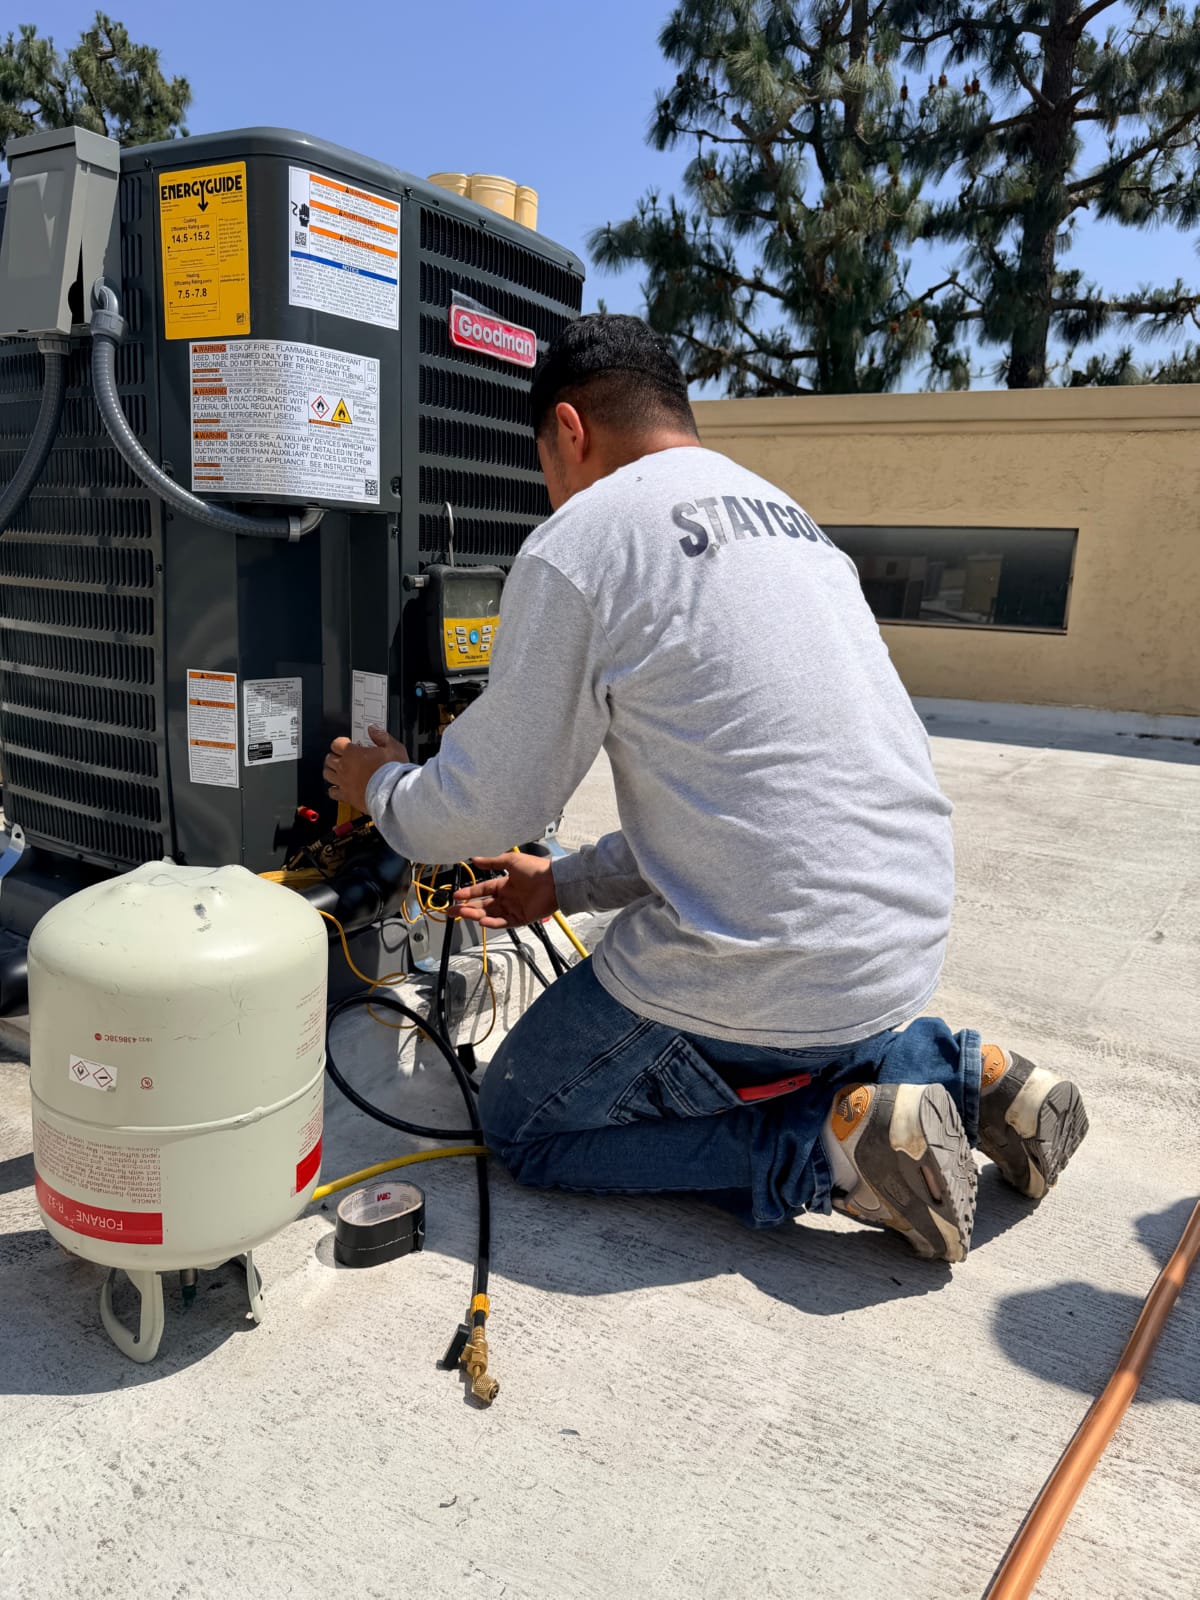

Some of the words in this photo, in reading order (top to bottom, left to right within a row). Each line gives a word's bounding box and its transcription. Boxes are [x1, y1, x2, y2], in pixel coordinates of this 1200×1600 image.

[161, 174, 242, 201] ENERGYGUIDE
[172, 233, 188, 244] 14.5
[194, 230, 210, 241] 15.2
[178, 289, 190, 299] 7.5
[195, 287, 207, 298] 7.8
[458, 315, 532, 357] Goodman
[229, 344, 244, 352] RISK
[276, 345, 318, 357] FLAMMABLE
[320, 351, 361, 366] REFRIGERANT
[230, 352, 260, 360] REPAIRED
[262, 352, 281, 360] ONLY
[284, 353, 294, 361] BY
[296, 355, 324, 366] TRAINED
[326, 360, 351, 373] SERVICE
[254, 360, 294, 369] PUNCTURE
[296, 363, 340, 377] REFRIGERANT
[229, 387, 244, 395] RISK
[244, 387, 252, 395] OF
[254, 387, 269, 395] FIRE
[275, 388, 308, 398] DISPOSE
[240, 395, 288, 403] ACCORDANCE
[289, 397, 309, 405] WITH
[229, 411, 271, 419] REFRIGERANT
[276, 433, 314, 444] AUXILIARY
[315, 438, 340, 448] DEVICES
[342, 442, 361, 451] WHICH
[363, 445, 375, 453] MAY
[284, 442, 299, 450] NOT
[313, 446, 344, 456] INSTALLED
[354, 451, 365, 459] THE
[271, 448, 309, 458] AUXILIARY
[311, 452, 337, 462] DEVICES
[338, 456, 358, 465] LISTED
[309, 460, 322, 468] SEE
[47, 1194, 64, 1214] R-32
[75, 1209, 124, 1231] FORANE
